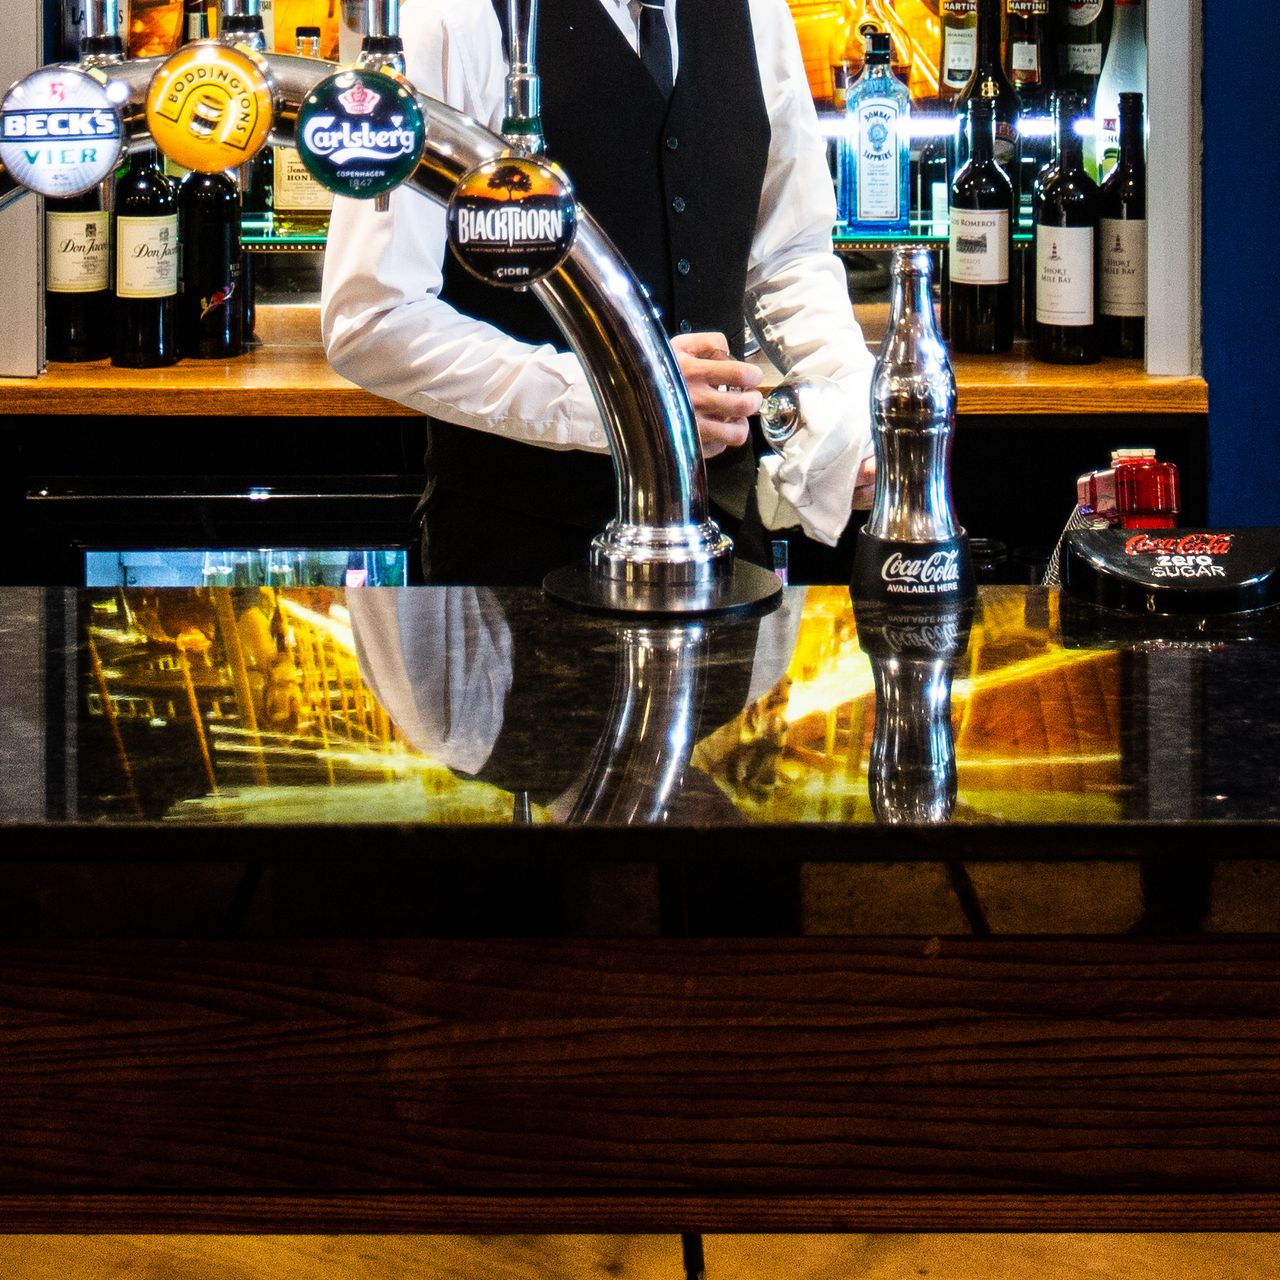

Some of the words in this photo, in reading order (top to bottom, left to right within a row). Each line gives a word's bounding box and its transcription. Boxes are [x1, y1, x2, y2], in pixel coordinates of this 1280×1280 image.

[943, 1, 977, 11] MARTIN
[1008, 1, 1046, 11] MARTINI
[168, 67, 251, 134] BODDINGTONS
[864, 110, 892, 122] BOMBAY
[4, 109, 115, 137] BECK'S
[303, 115, 416, 162] Carlsberg
[23, 148, 98, 165] VIER
[862, 150, 893, 161] SAPPHIRE
[349, 179, 373, 187] 1847
[458, 206, 563, 248] BLACKTHORN
[960, 219, 996, 227] ROMEROS
[59, 239, 85, 253] Don
[133, 243, 160, 258] Don
[1107, 258, 1131, 267] SHORT
[496, 267, 530, 276] CIDER
[1043, 266, 1067, 276] SHORT
[1121, 268, 1136, 276] BAY
[1041, 275, 1056, 284] MILE
[1058, 275, 1071, 284] BAY
[1155, 555, 1213, 567] zero
[1151, 565, 1226, 578] SUGAR
[887, 584, 936, 594] AVAILABLE
[936, 582, 959, 593] HERE
